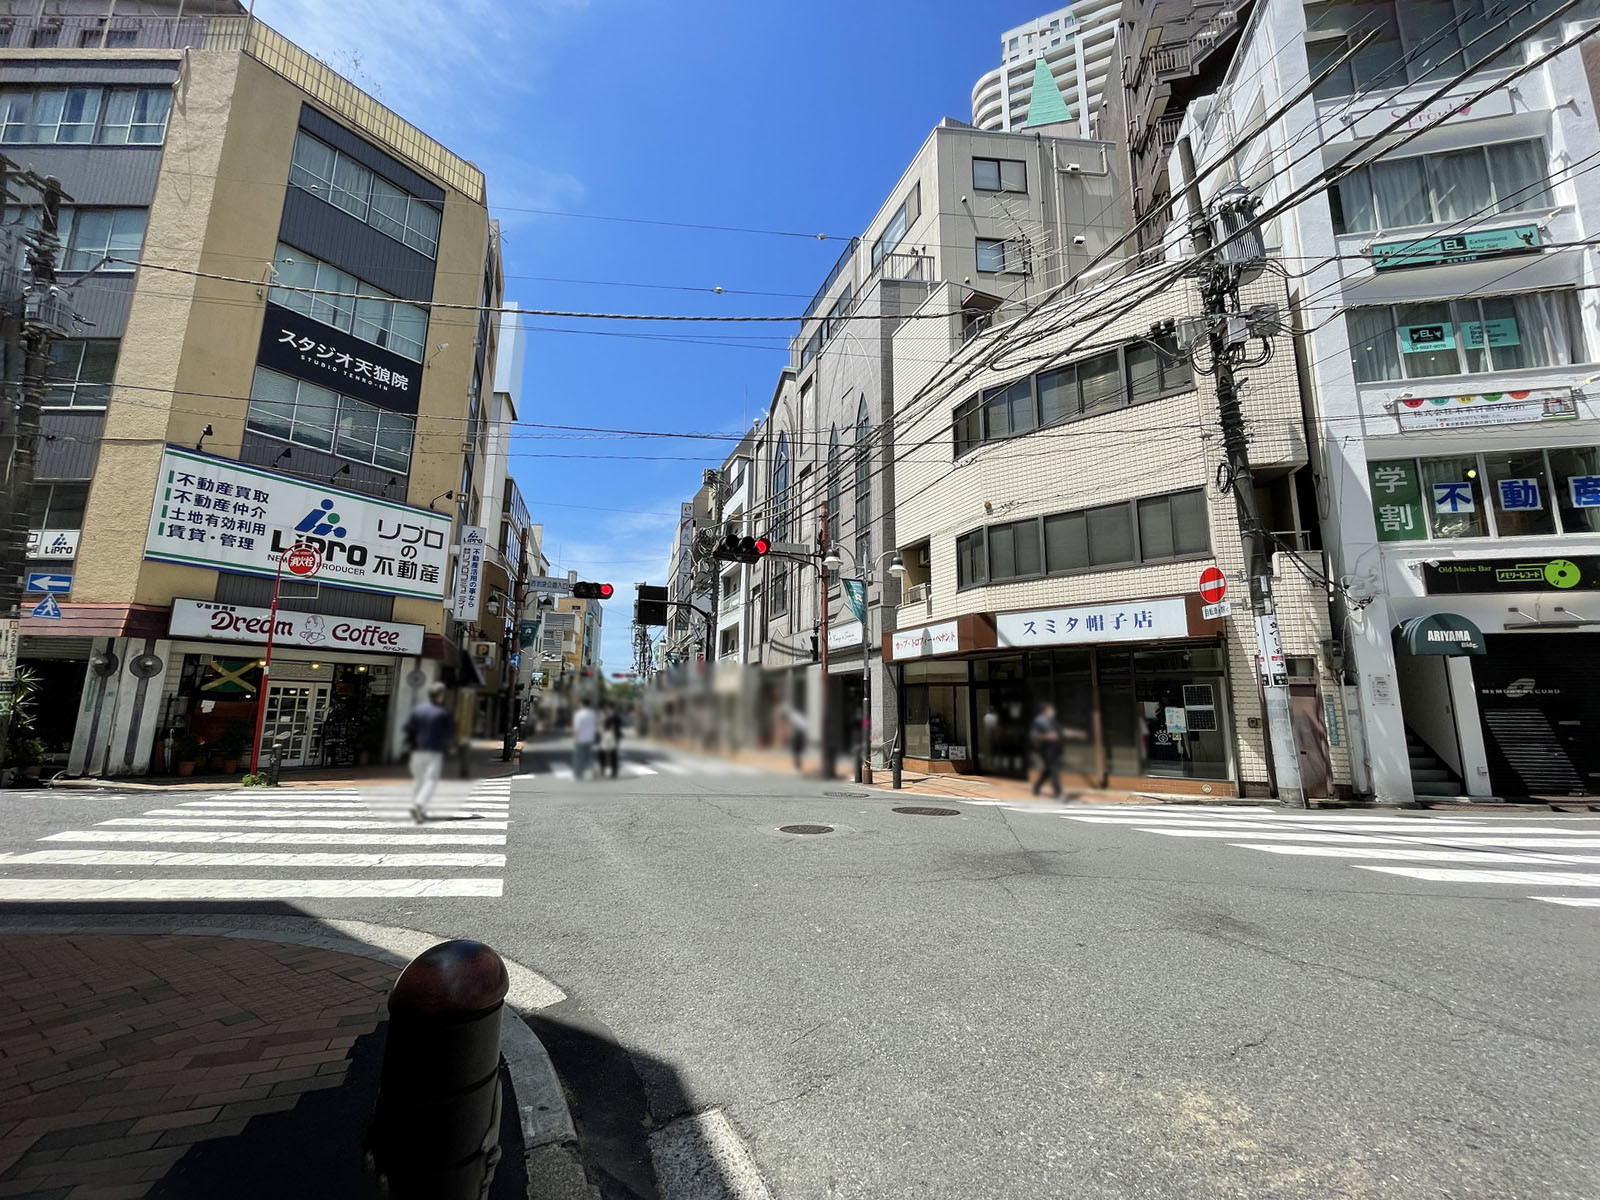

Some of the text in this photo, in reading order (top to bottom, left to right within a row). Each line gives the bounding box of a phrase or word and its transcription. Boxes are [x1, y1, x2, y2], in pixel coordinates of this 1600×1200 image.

[278, 329, 409, 391] スタジオ天狼院
[300, 354, 388, 391] STUDIO TENRO-IN
[177, 472, 270, 504] 不動産買取
[1375, 467, 1414, 532] 学割
[173, 489, 267, 519] 不動産仲介
[169, 507, 266, 536] 土地有効利用
[378, 519, 444, 549] リプロ
[167, 524, 254, 550] 賃貸・管理
[290, 555, 314, 567] 消火栓
[401, 545, 417, 559] の
[372, 555, 440, 584] 不動産
[1438, 564, 1492, 574] Old Music Bar
[211, 610, 400, 646] Dream Coffee
[1023, 611, 1153, 636] スミタ帽子店
[1427, 630, 1471, 642] ARIYAMA
